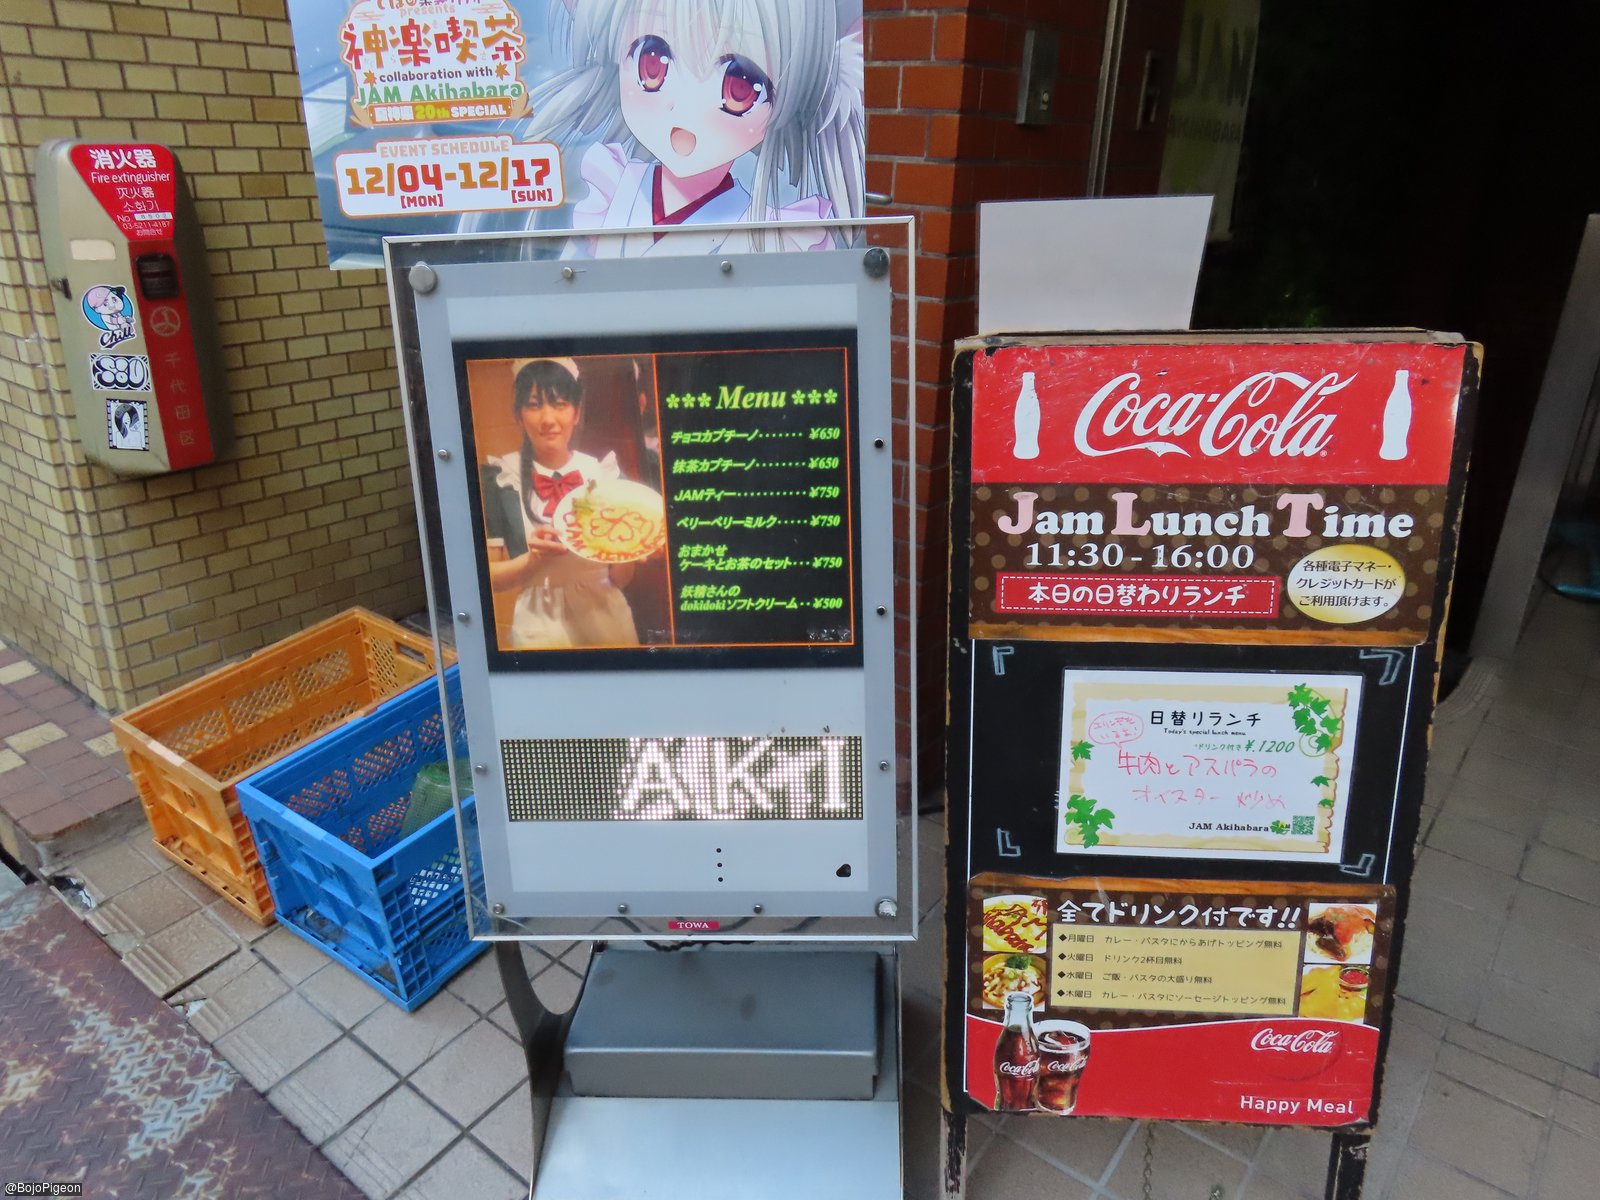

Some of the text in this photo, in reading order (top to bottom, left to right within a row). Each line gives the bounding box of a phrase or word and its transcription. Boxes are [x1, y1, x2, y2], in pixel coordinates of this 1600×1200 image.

[400, 3, 456, 17] presents
[343, 13, 522, 70] 神楽喫茶
[379, 66, 493, 83] collaboration with
[357, 81, 523, 105] JAM Akihabara
[415, 104, 450, 120] 20th
[450, 104, 507, 118] SPECIAL
[380, 140, 510, 159] EVENT SCHEDULE
[89, 148, 157, 169] 消火器
[90, 171, 170, 185] Fire extinguisher
[345, 157, 551, 196] 12/04-12/17
[123, 200, 159, 212] 소화기
[100, 326, 135, 348] Chill
[715, 386, 786, 409] Menu
[1073, 370, 1358, 458] Coca-Cola
[809, 427, 840, 440] ¥650
[808, 457, 839, 469] ¥650
[809, 486, 840, 498] ¥750
[810, 515, 840, 527] ¥750
[997, 492, 1415, 537] Jam Lunch Time
[678, 545, 728, 558] おまかせ
[1026, 544, 1124, 568] 11:30
[1151, 543, 1255, 569] 16:00
[812, 557, 842, 568] ¥750
[680, 585, 740, 598] 妖精さんの
[1296, 578, 1396, 590] クレジットカードが
[1028, 580, 1247, 607] 本日の日替わりランチ
[1299, 595, 1389, 607] ご利用頂けます。
[813, 597, 842, 609] ¥500
[1118, 749, 1278, 778] 牛肉とアスパラの
[1188, 822, 1213, 831] JAM
[1215, 823, 1269, 833] Akihabara
[676, 921, 710, 929] TOWA
[1251, 1026, 1340, 1054] Coca-Cola
[1240, 1095, 1354, 1115] Happy Meal
